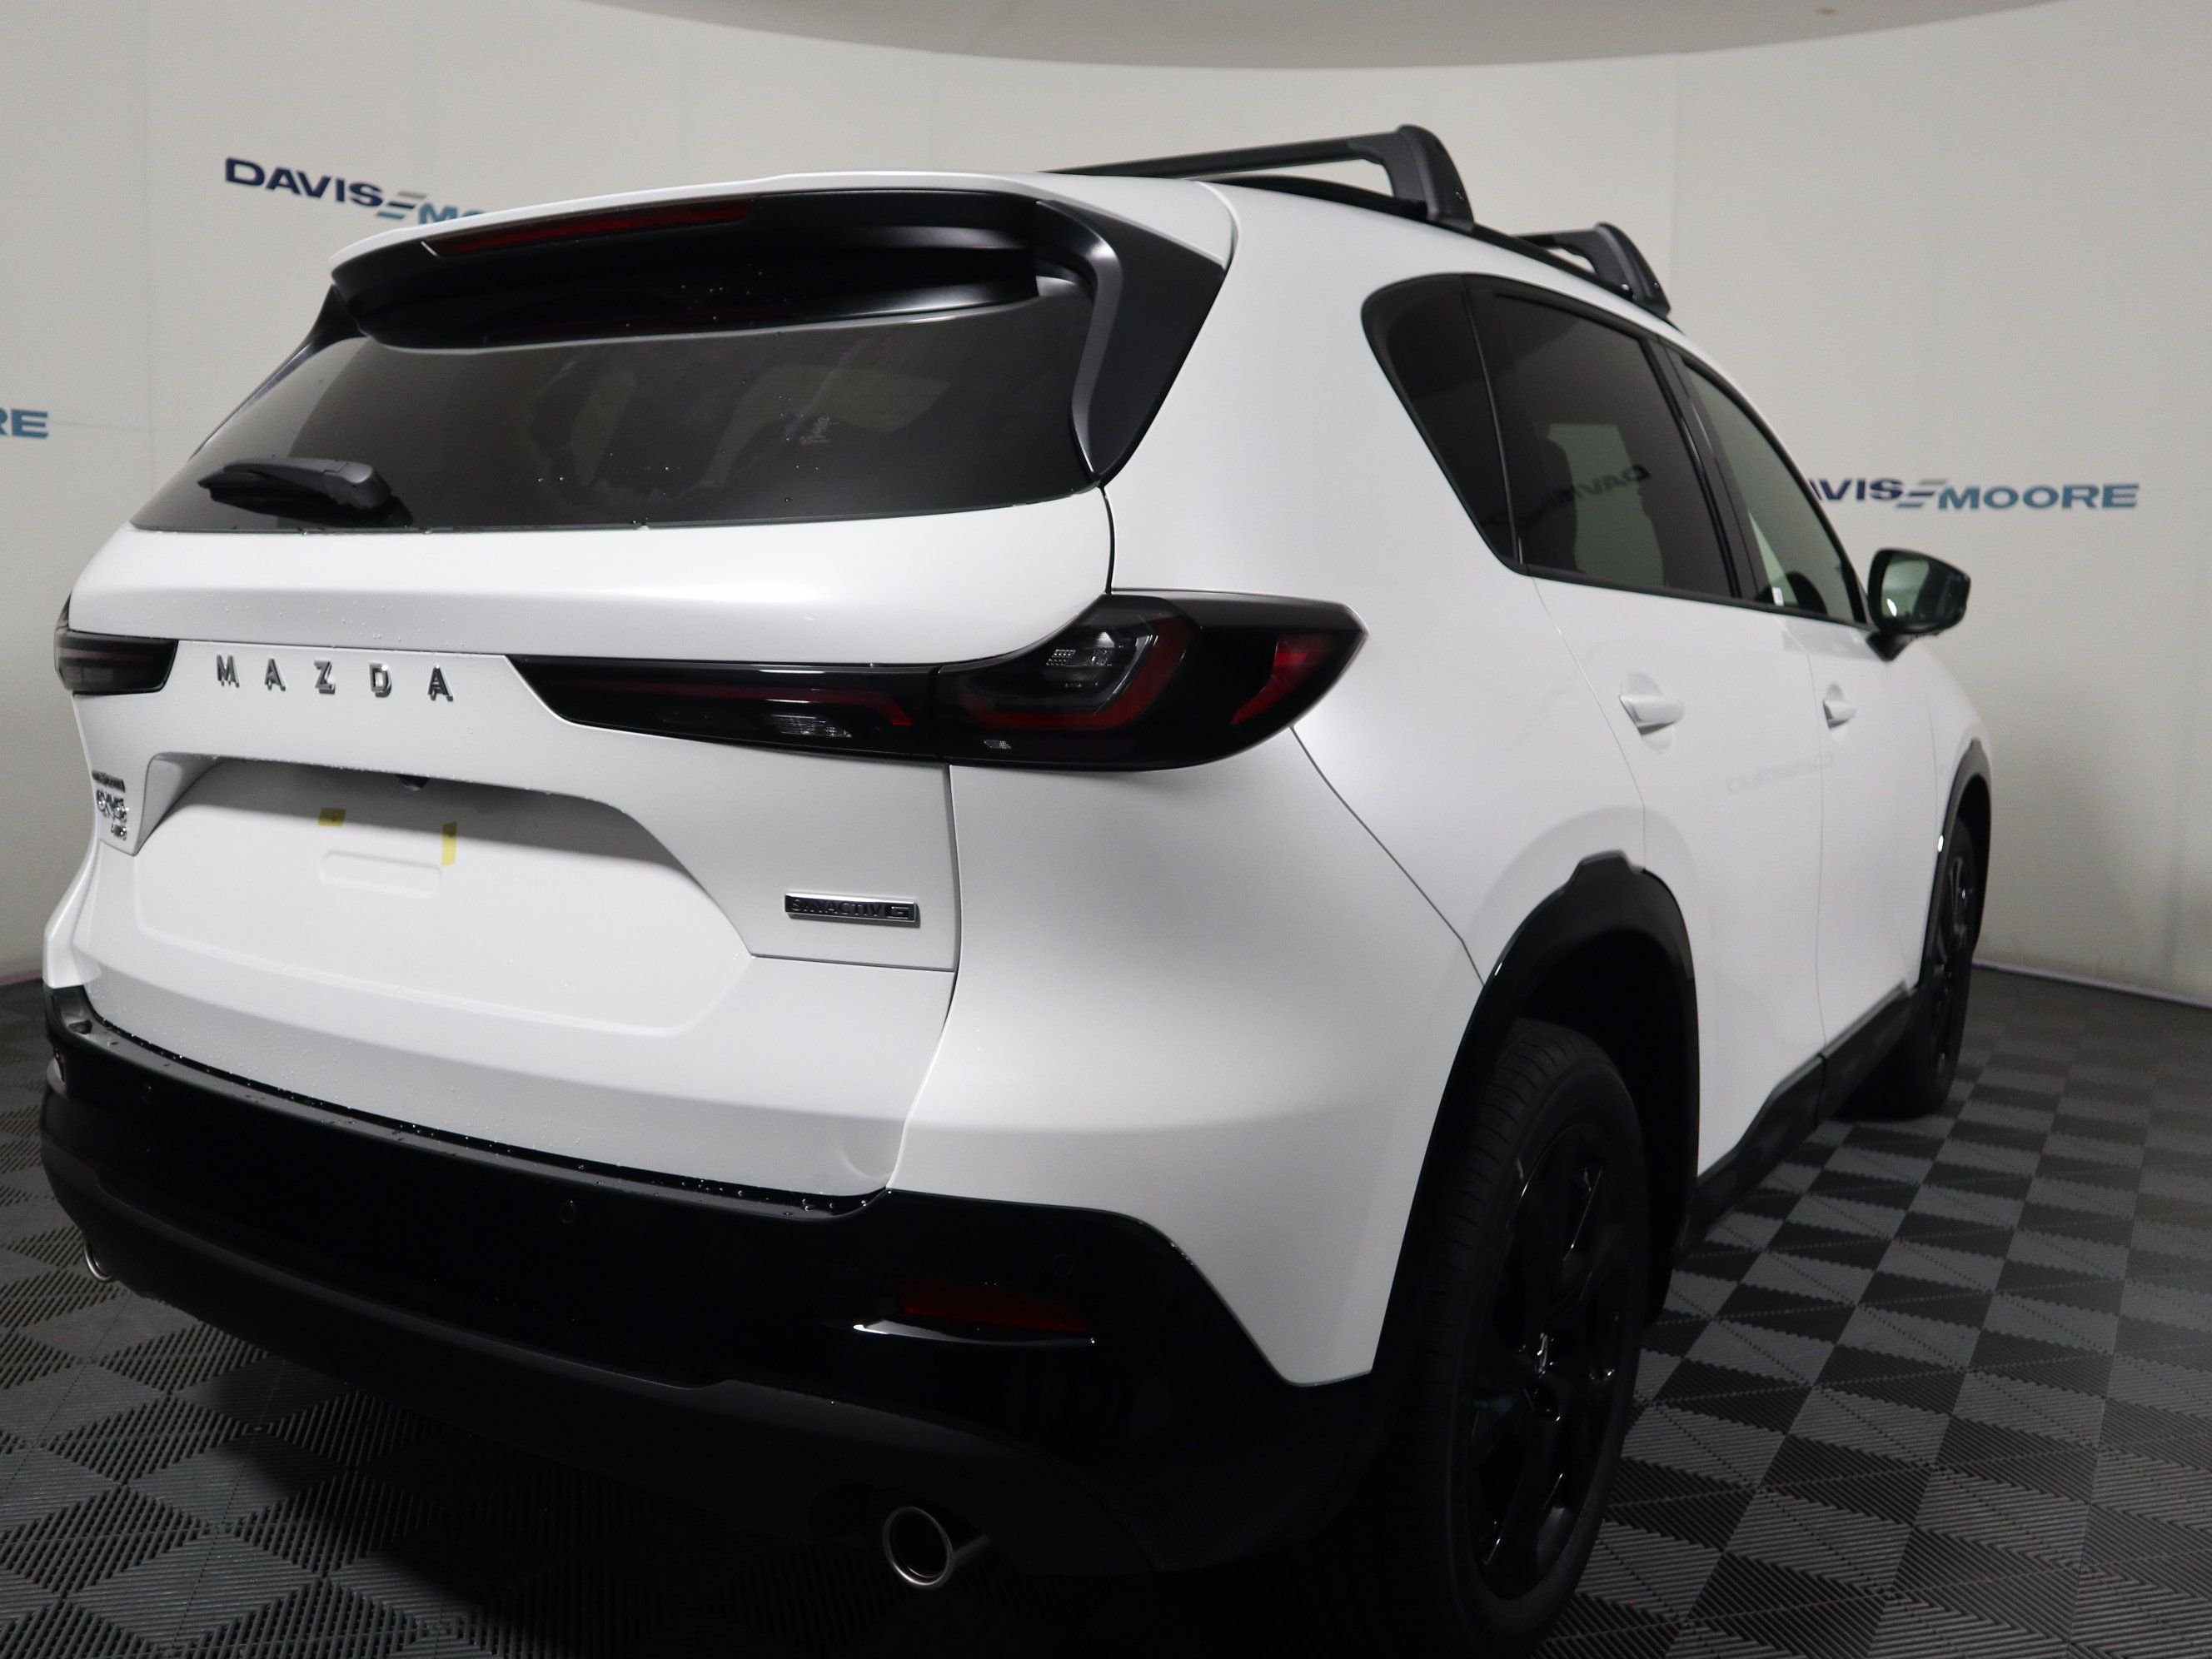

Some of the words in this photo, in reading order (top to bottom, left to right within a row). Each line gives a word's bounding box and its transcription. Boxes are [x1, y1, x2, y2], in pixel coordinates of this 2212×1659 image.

[224, 157, 383, 207] DAVIS
[1809, 478, 1904, 501] VIS
[1937, 483, 2140, 511] MOORE
[216, 655, 452, 700] MAZDA
